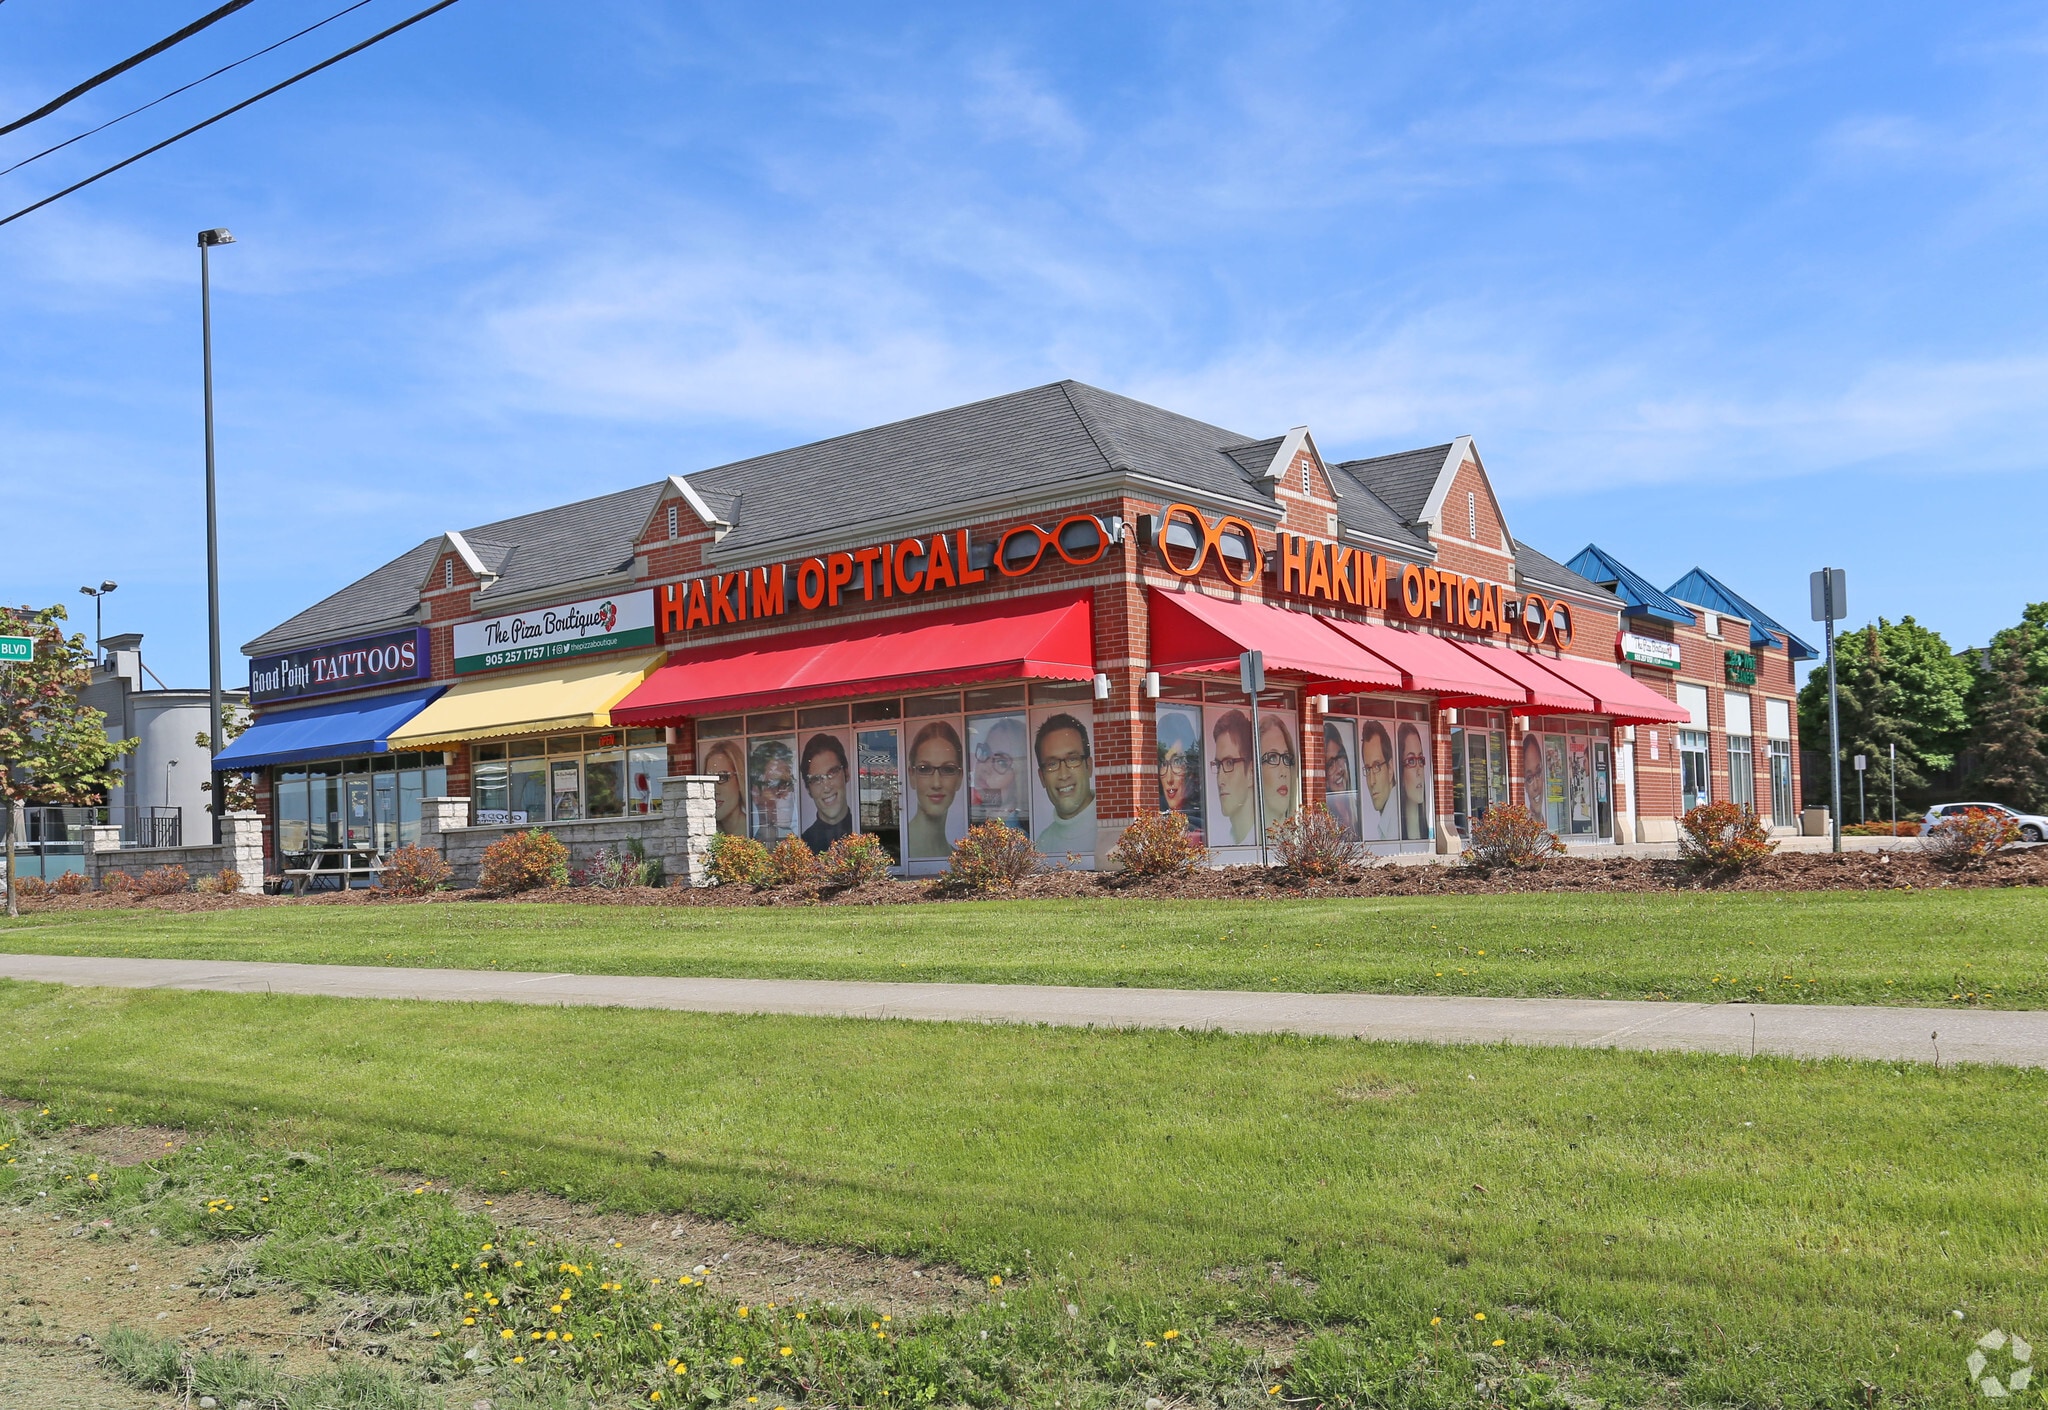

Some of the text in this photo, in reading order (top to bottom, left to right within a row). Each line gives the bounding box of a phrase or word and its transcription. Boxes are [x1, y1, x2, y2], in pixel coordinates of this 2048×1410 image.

[661, 529, 985, 633] HAKIM OPTICAL
[1279, 532, 1512, 634] HAKIM OPTICAL
[485, 607, 603, 646] The Pizza Boutique
[1, 643, 27, 655] BLVD
[485, 646, 545, 666] 905 257 1757
[570, 637, 618, 652] thepizzaboutique
[252, 641, 416, 693] Good Point TATTOOS
[599, 734, 615, 747] OPEN
